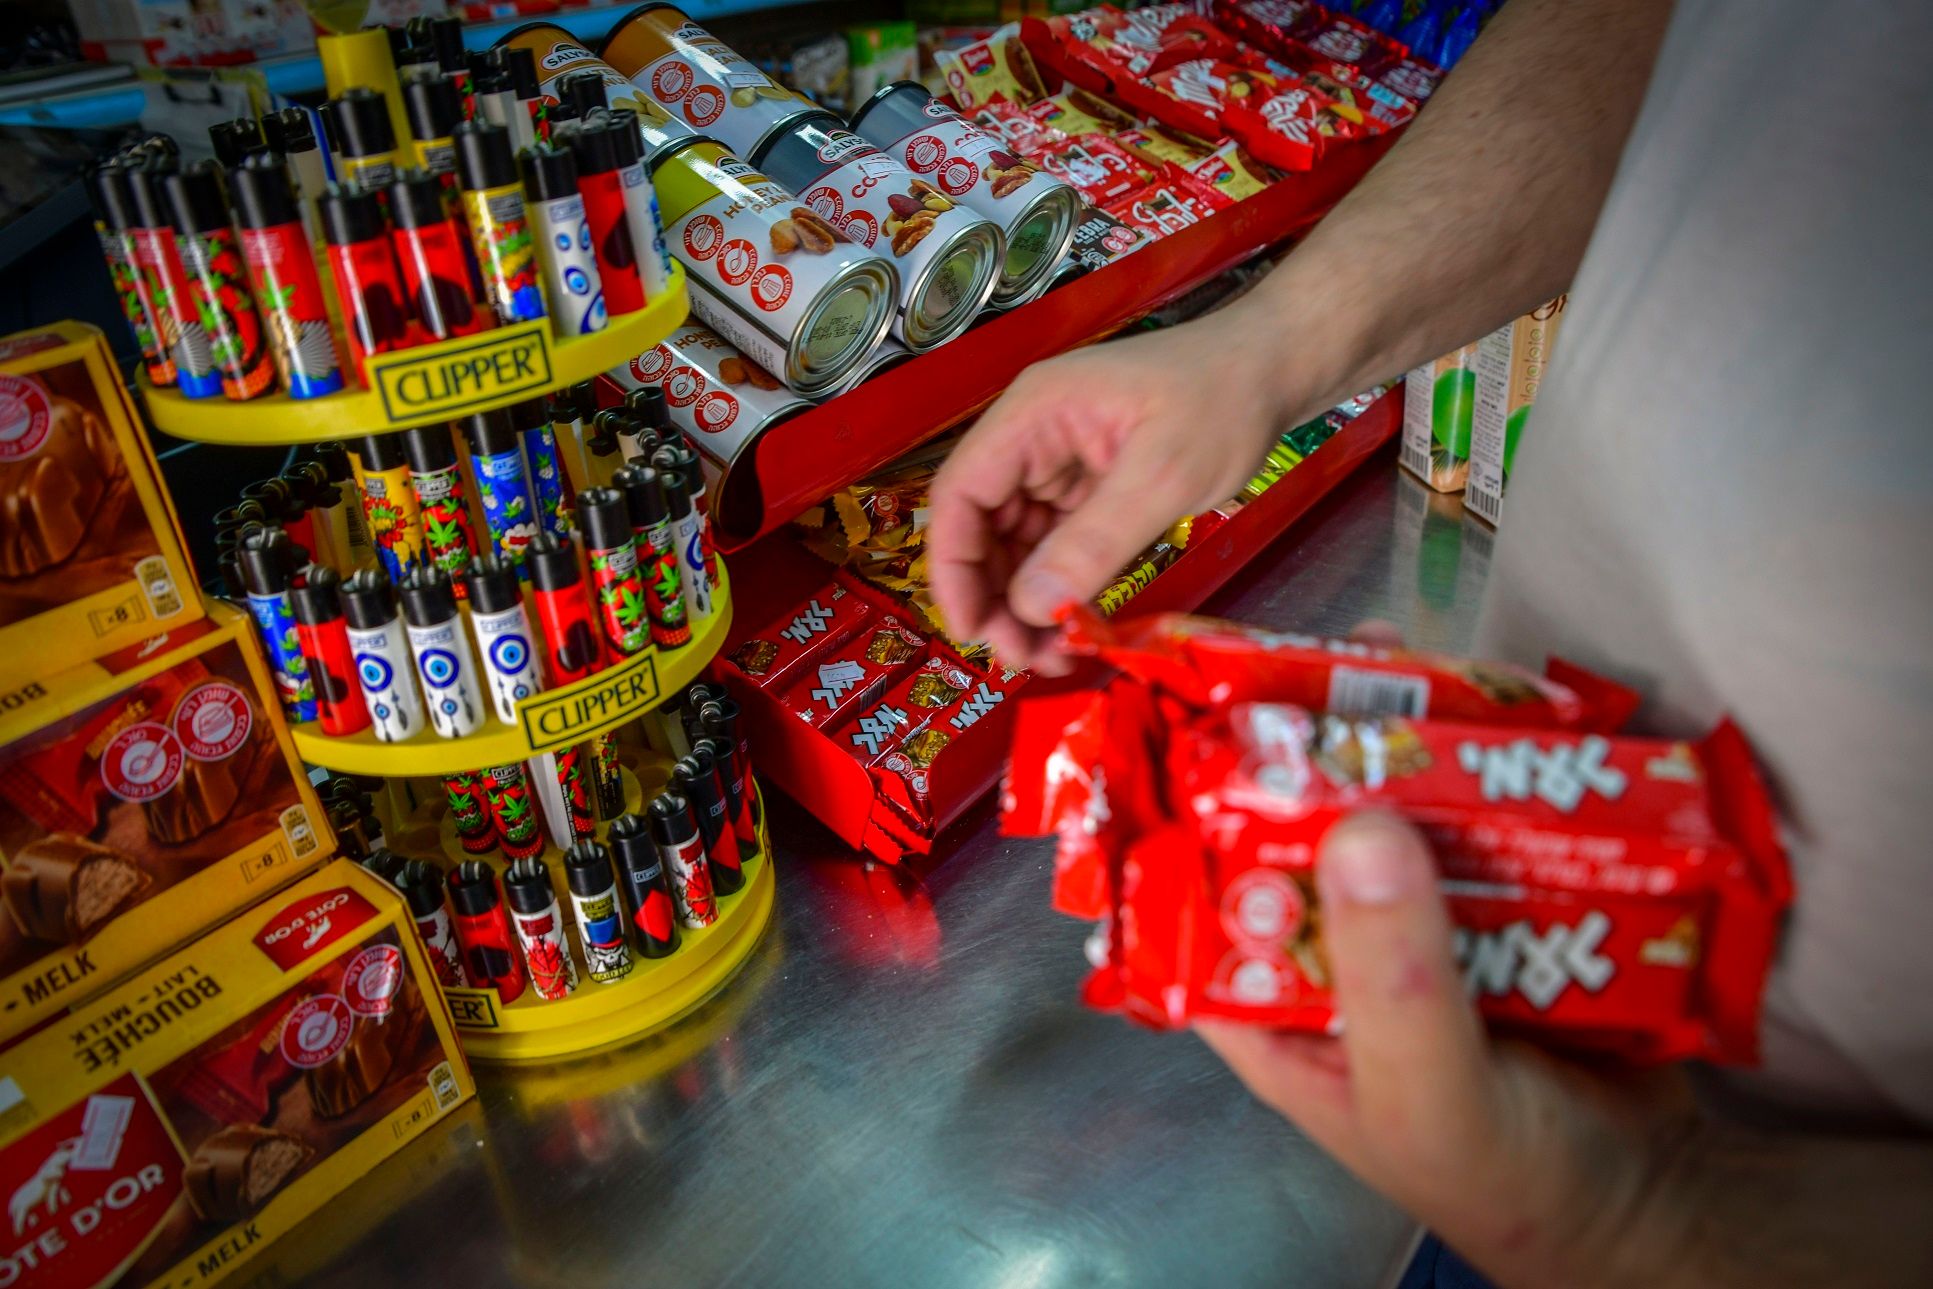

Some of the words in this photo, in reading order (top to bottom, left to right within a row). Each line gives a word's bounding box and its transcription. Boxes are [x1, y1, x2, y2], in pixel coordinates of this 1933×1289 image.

[396, 346, 536, 406] CLIPPER
[539, 673, 647, 735] CLIPPER
[23, 951, 97, 1005] MELK
[153, 964, 200, 998] LAIT
[70, 1006, 132, 1046] MELK
[73, 975, 223, 1074] BOUCHÉE
[70, 1164, 165, 1236] D'OR
[197, 1224, 262, 1278] MELK
